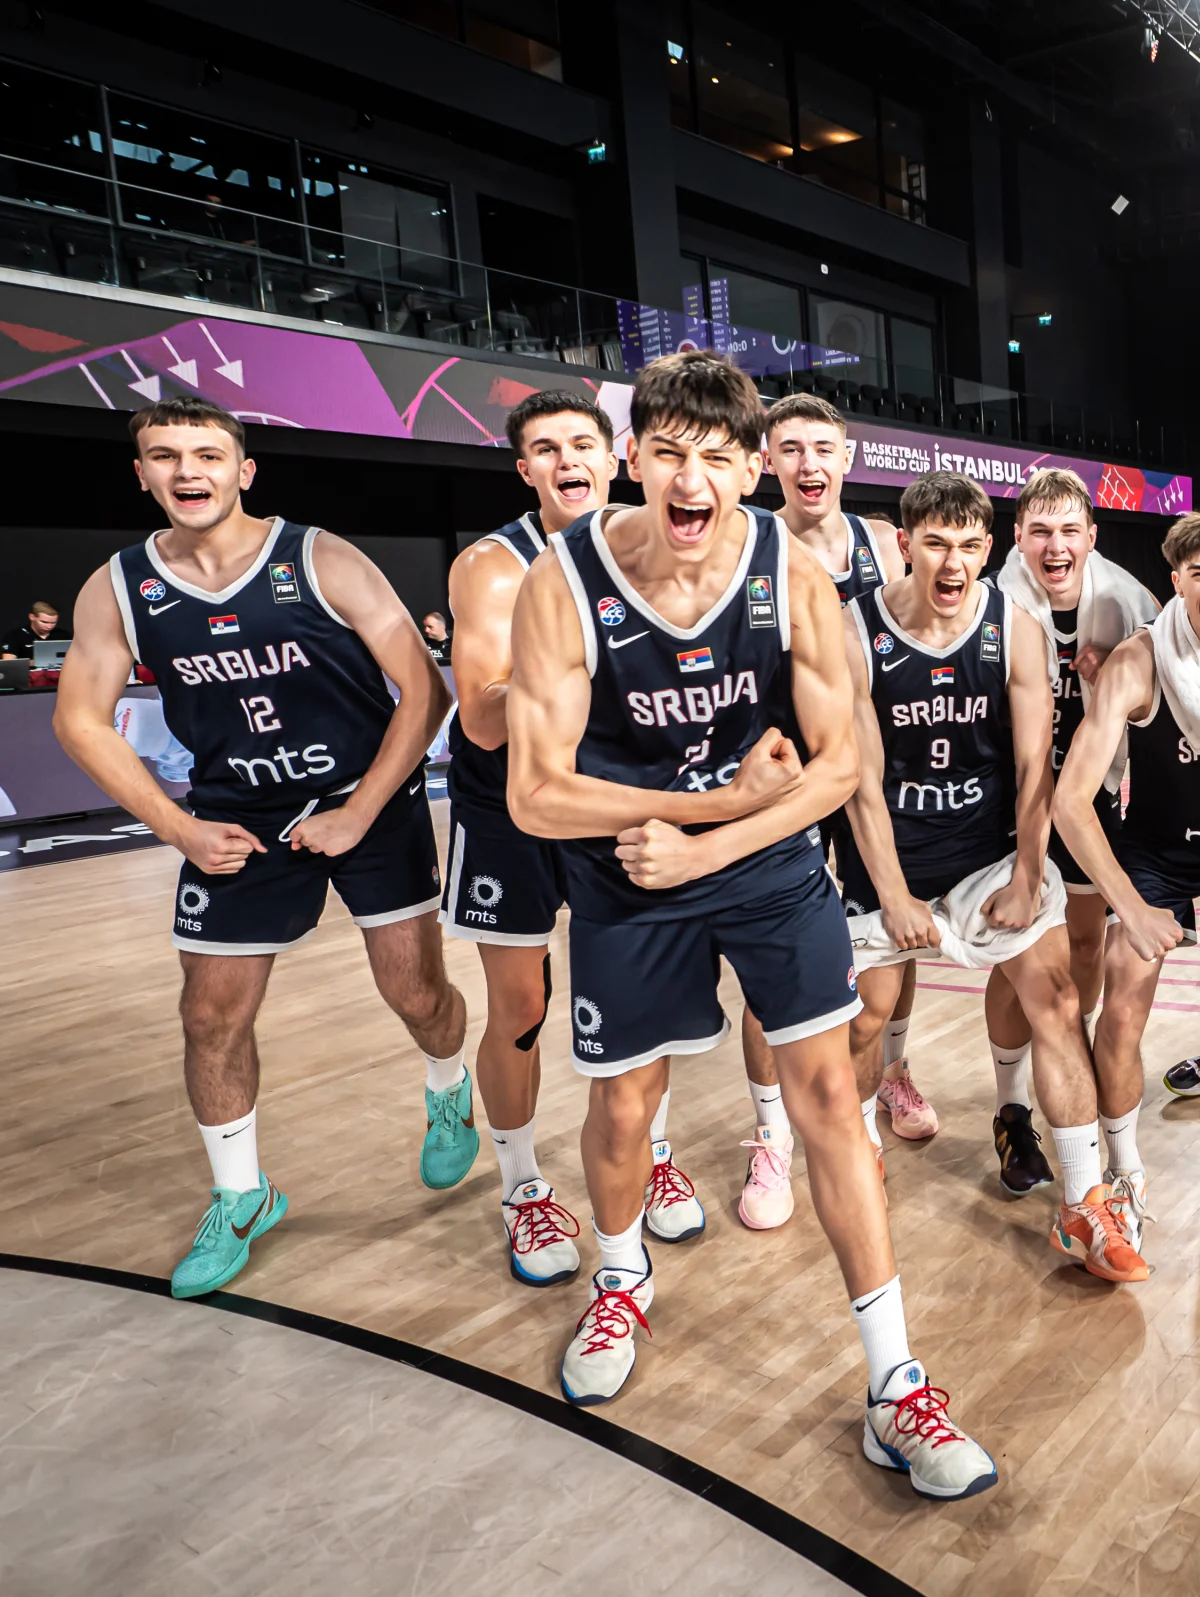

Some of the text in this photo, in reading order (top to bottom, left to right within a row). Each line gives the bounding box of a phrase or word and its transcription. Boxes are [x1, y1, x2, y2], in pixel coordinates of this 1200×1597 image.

[862, 441, 930, 461] BASKETBALL
[864, 454, 930, 473] WORLD CUP
[934, 443, 1026, 484] İSTANBUL
[276, 584, 294, 592] FIBA
[173, 642, 310, 685] SRBIJA
[892, 695, 988, 727] SRBIJA
[228, 743, 335, 786] mts
[931, 739, 950, 769] 9
[898, 777, 983, 810] mts
[177, 917, 202, 932] mts
[466, 910, 497, 924] mts
